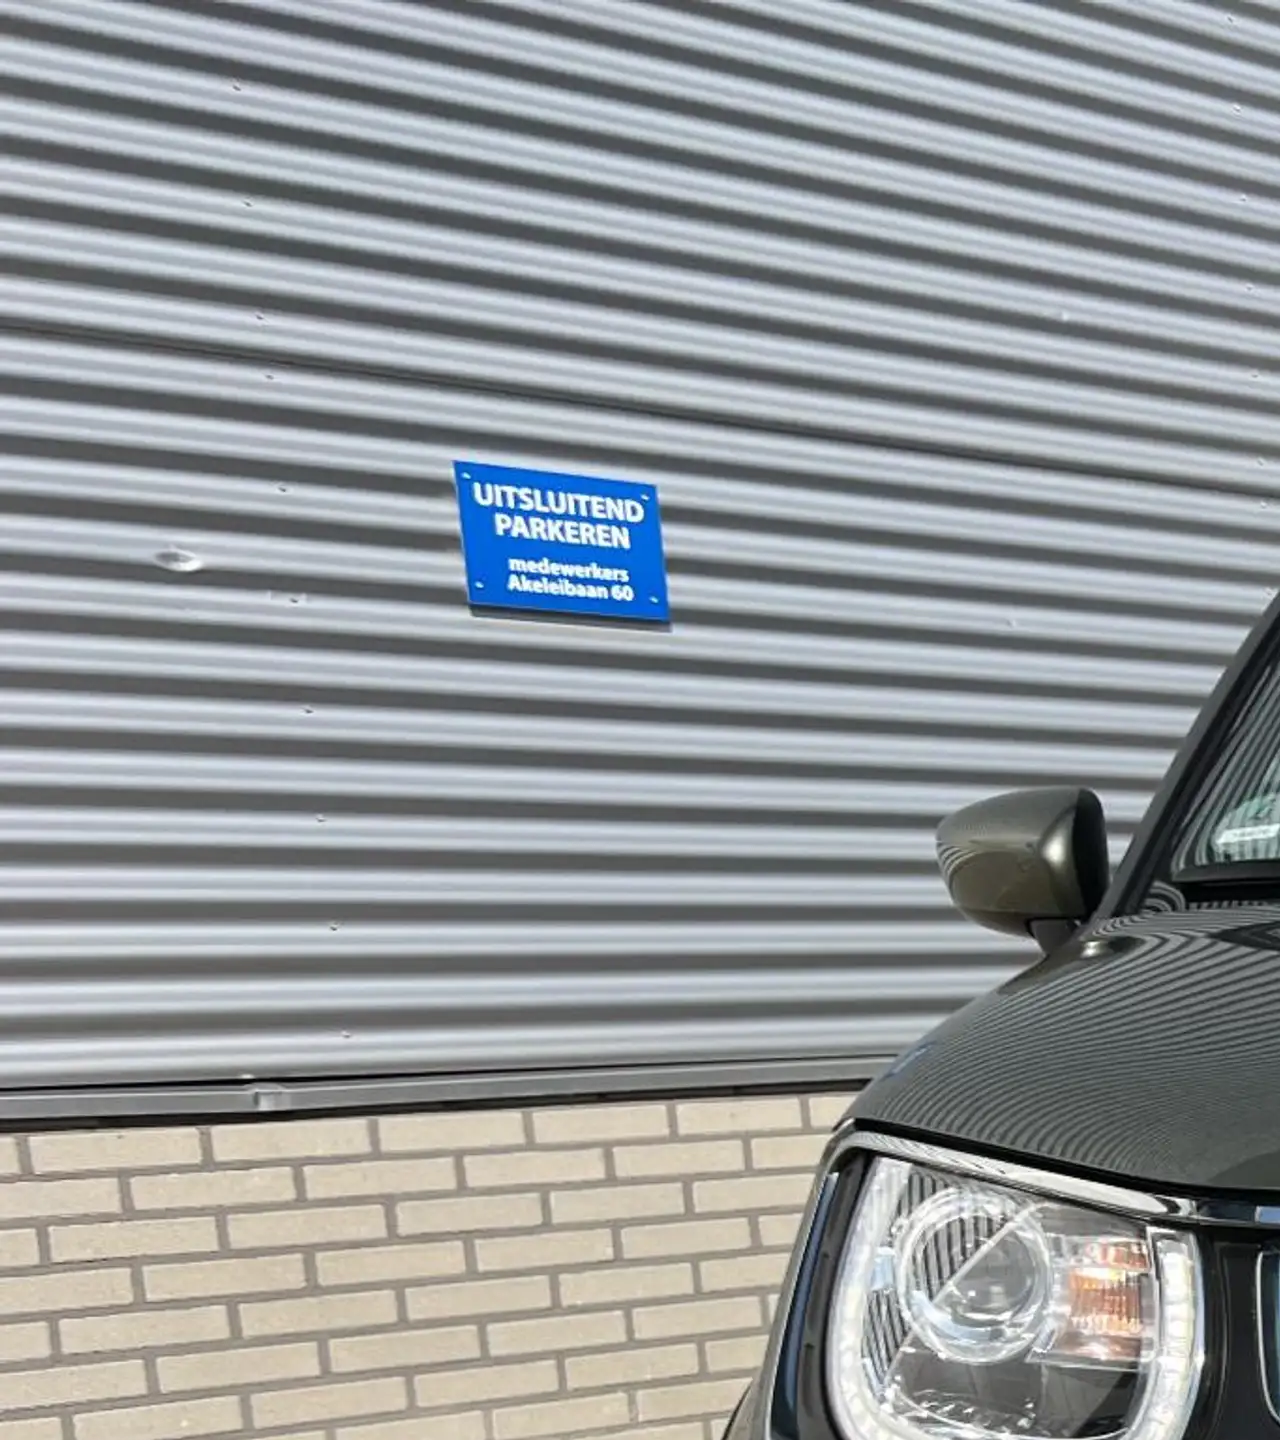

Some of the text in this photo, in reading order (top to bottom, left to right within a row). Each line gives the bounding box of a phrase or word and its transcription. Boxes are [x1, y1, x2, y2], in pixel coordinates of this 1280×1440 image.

[473, 482, 645, 523] UITSLUITEND
[494, 513, 631, 550] PARKEREN
[508, 557, 629, 583] medewerkers
[507, 574, 635, 602] Akeleibaan 60
